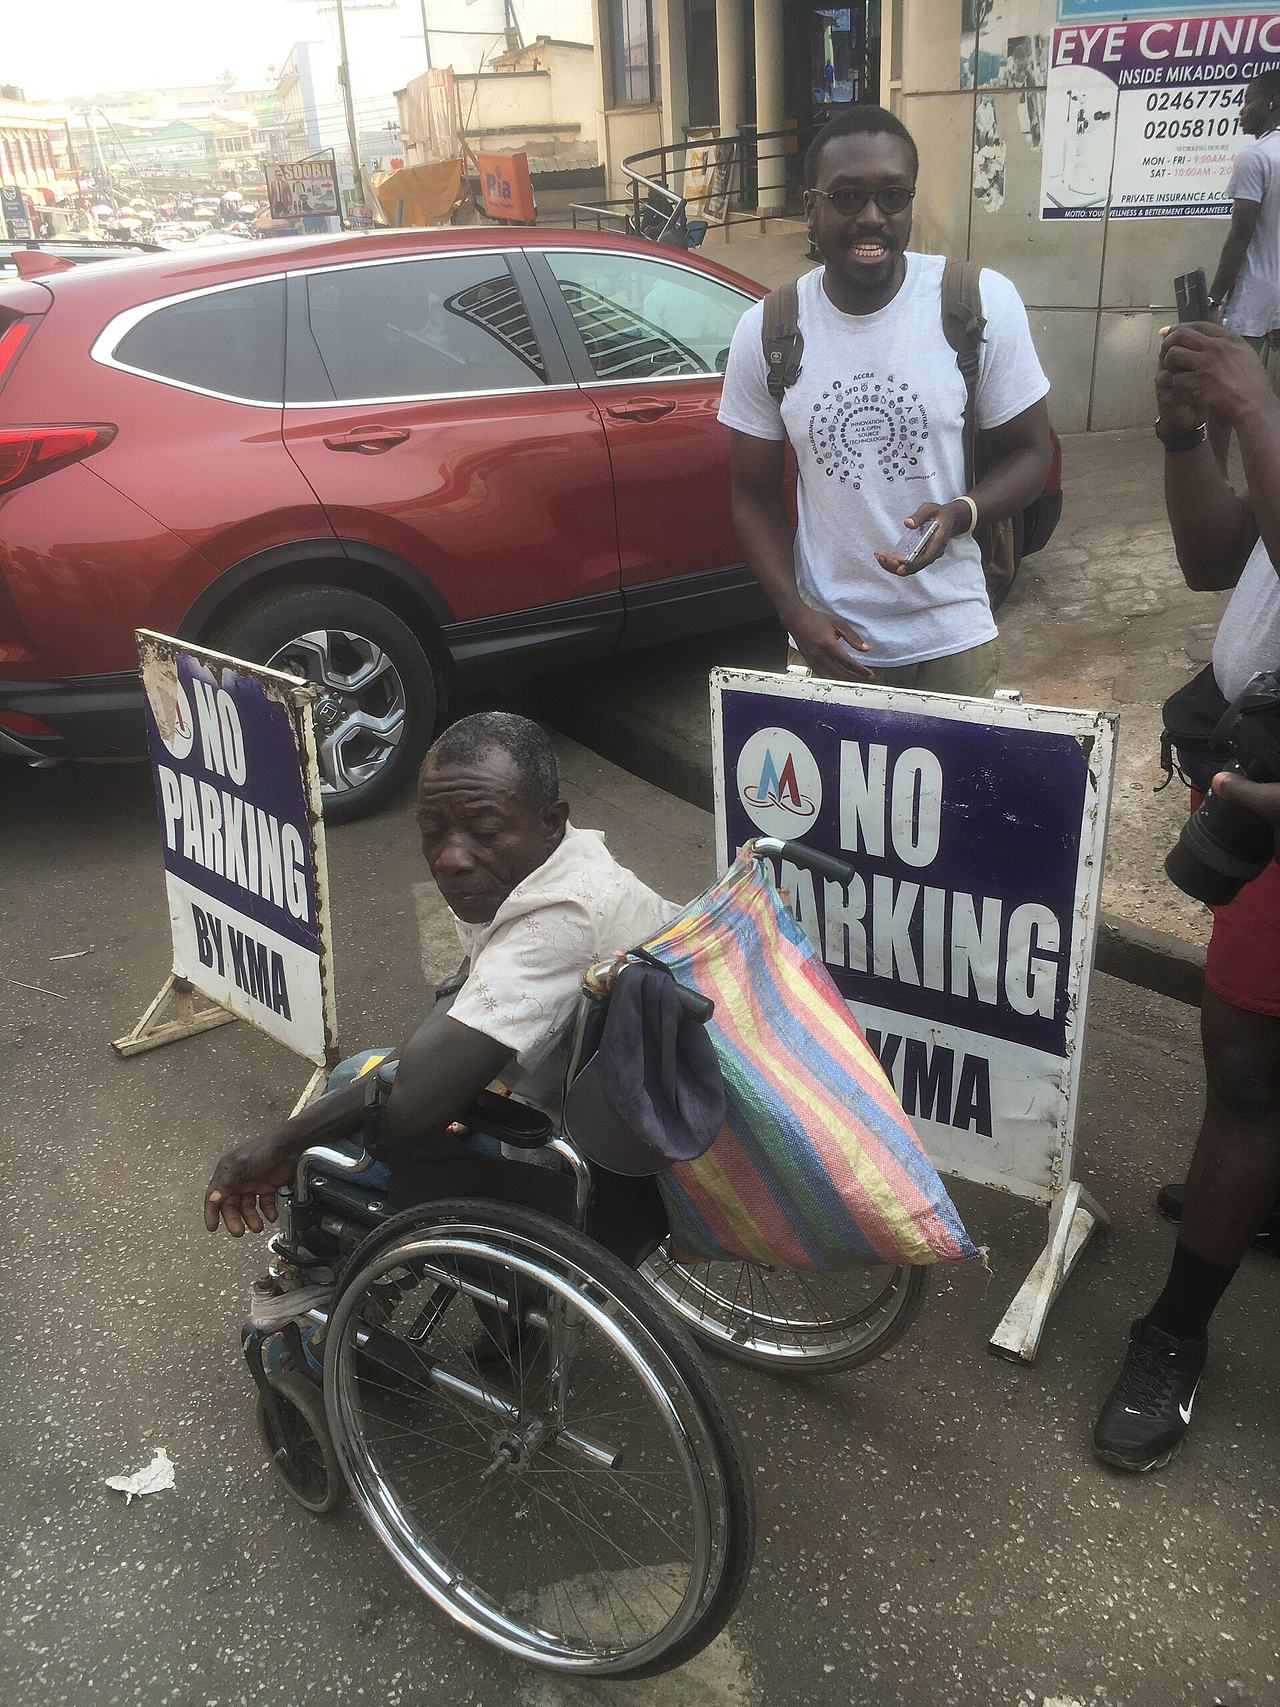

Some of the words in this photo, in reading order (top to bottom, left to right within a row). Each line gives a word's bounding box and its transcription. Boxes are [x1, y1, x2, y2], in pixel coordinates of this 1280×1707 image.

[1055, 26, 1128, 65] EYE
[1139, 16, 1280, 60] CLINIC
[1118, 67, 1164, 85] INSIDE
[1165, 63, 1238, 83] MIKADDO
[1142, 156, 1165, 166] MON
[1172, 155, 1186, 165] FRI
[1150, 169, 1166, 178] SAT
[1121, 194, 1154, 203] PRIVATE
[1156, 192, 1205, 203] INSURANCE
[1207, 191, 1230, 201] ACC
[1064, 209, 1088, 218] MOTTO:
[1145, 207, 1184, 217] BETTERMENT
[1185, 206, 1227, 216] GUARANTEES
[853, 372, 875, 381] ACCRA
[845, 386, 859, 396] SFD
[850, 419, 885, 428] INNOVATION
[193, 677, 247, 787] NO
[839, 739, 943, 868] NO
[158, 764, 309, 924] PARKING
[191, 902, 226, 979] BY
[227, 923, 293, 1022] KMA
